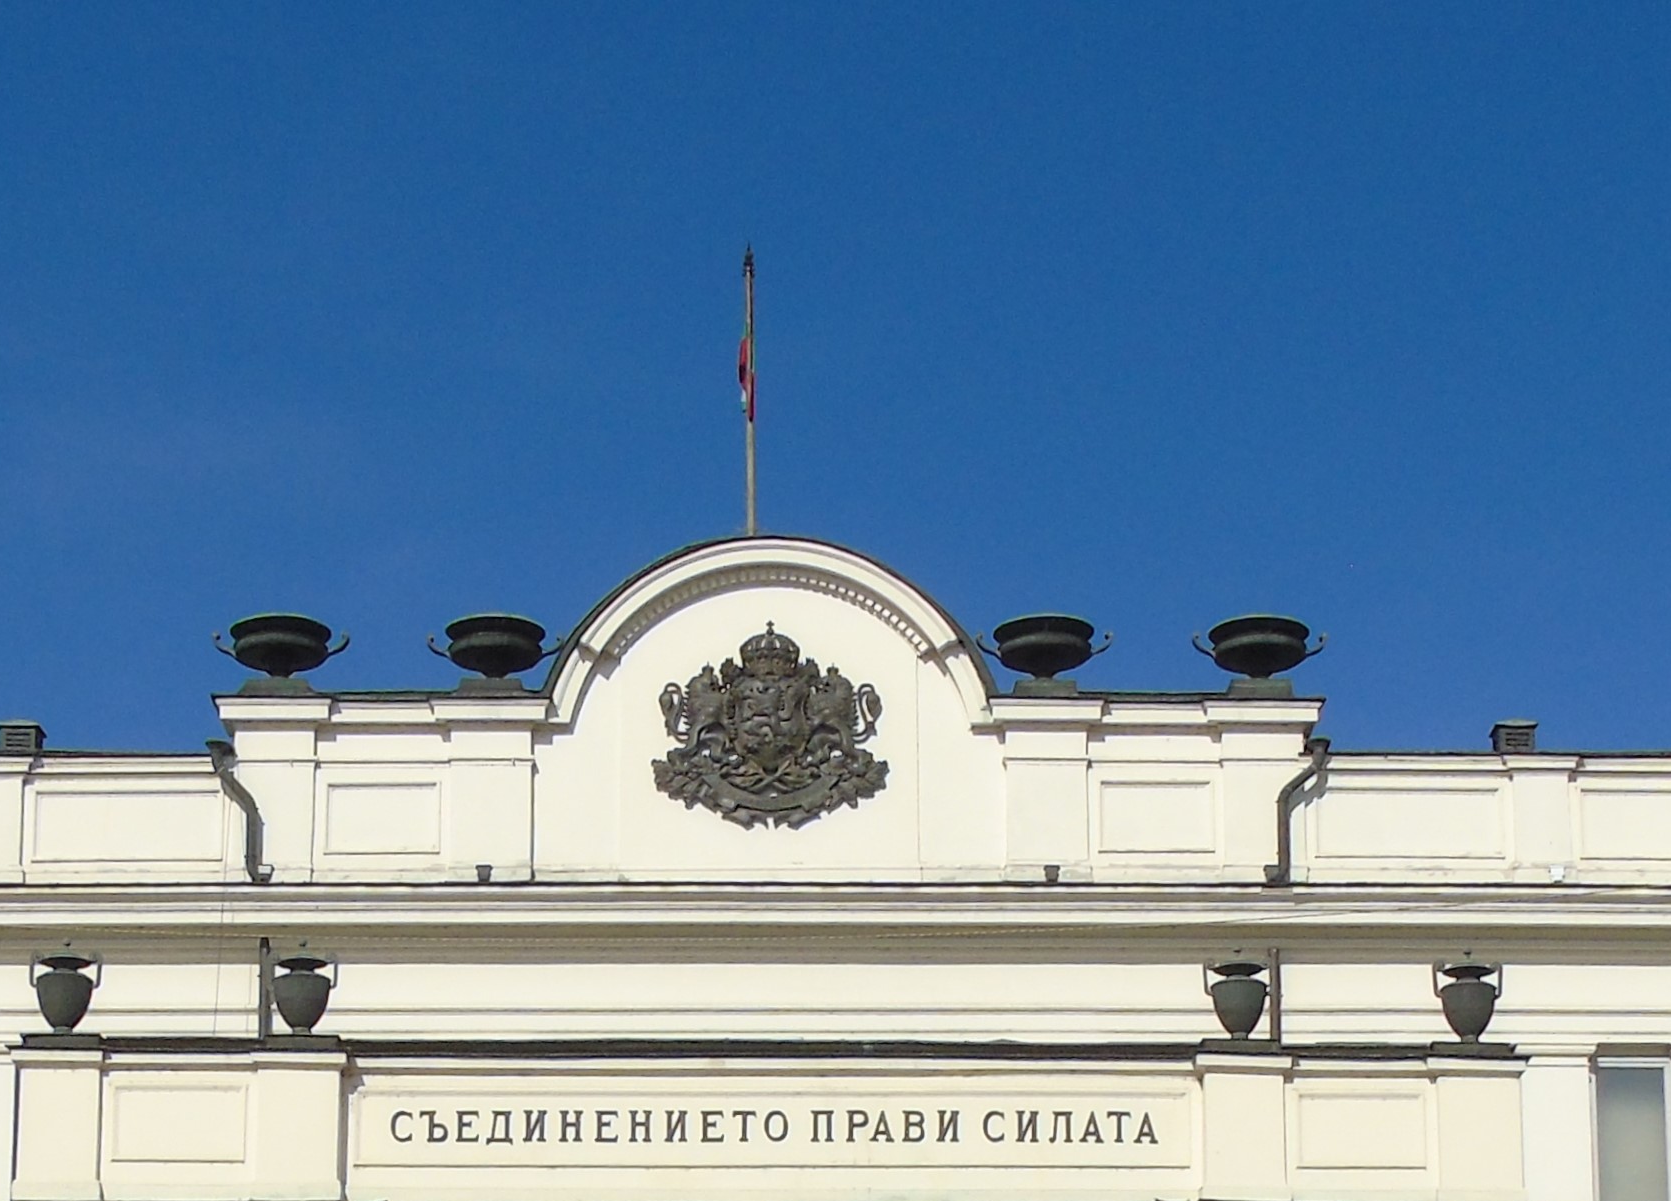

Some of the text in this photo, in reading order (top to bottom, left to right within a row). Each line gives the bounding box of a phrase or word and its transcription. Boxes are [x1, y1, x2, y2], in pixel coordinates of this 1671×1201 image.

[390, 1109, 1159, 1146] СЪЕДИНЕНИЕТО ПРАВИ СИЛАТА
